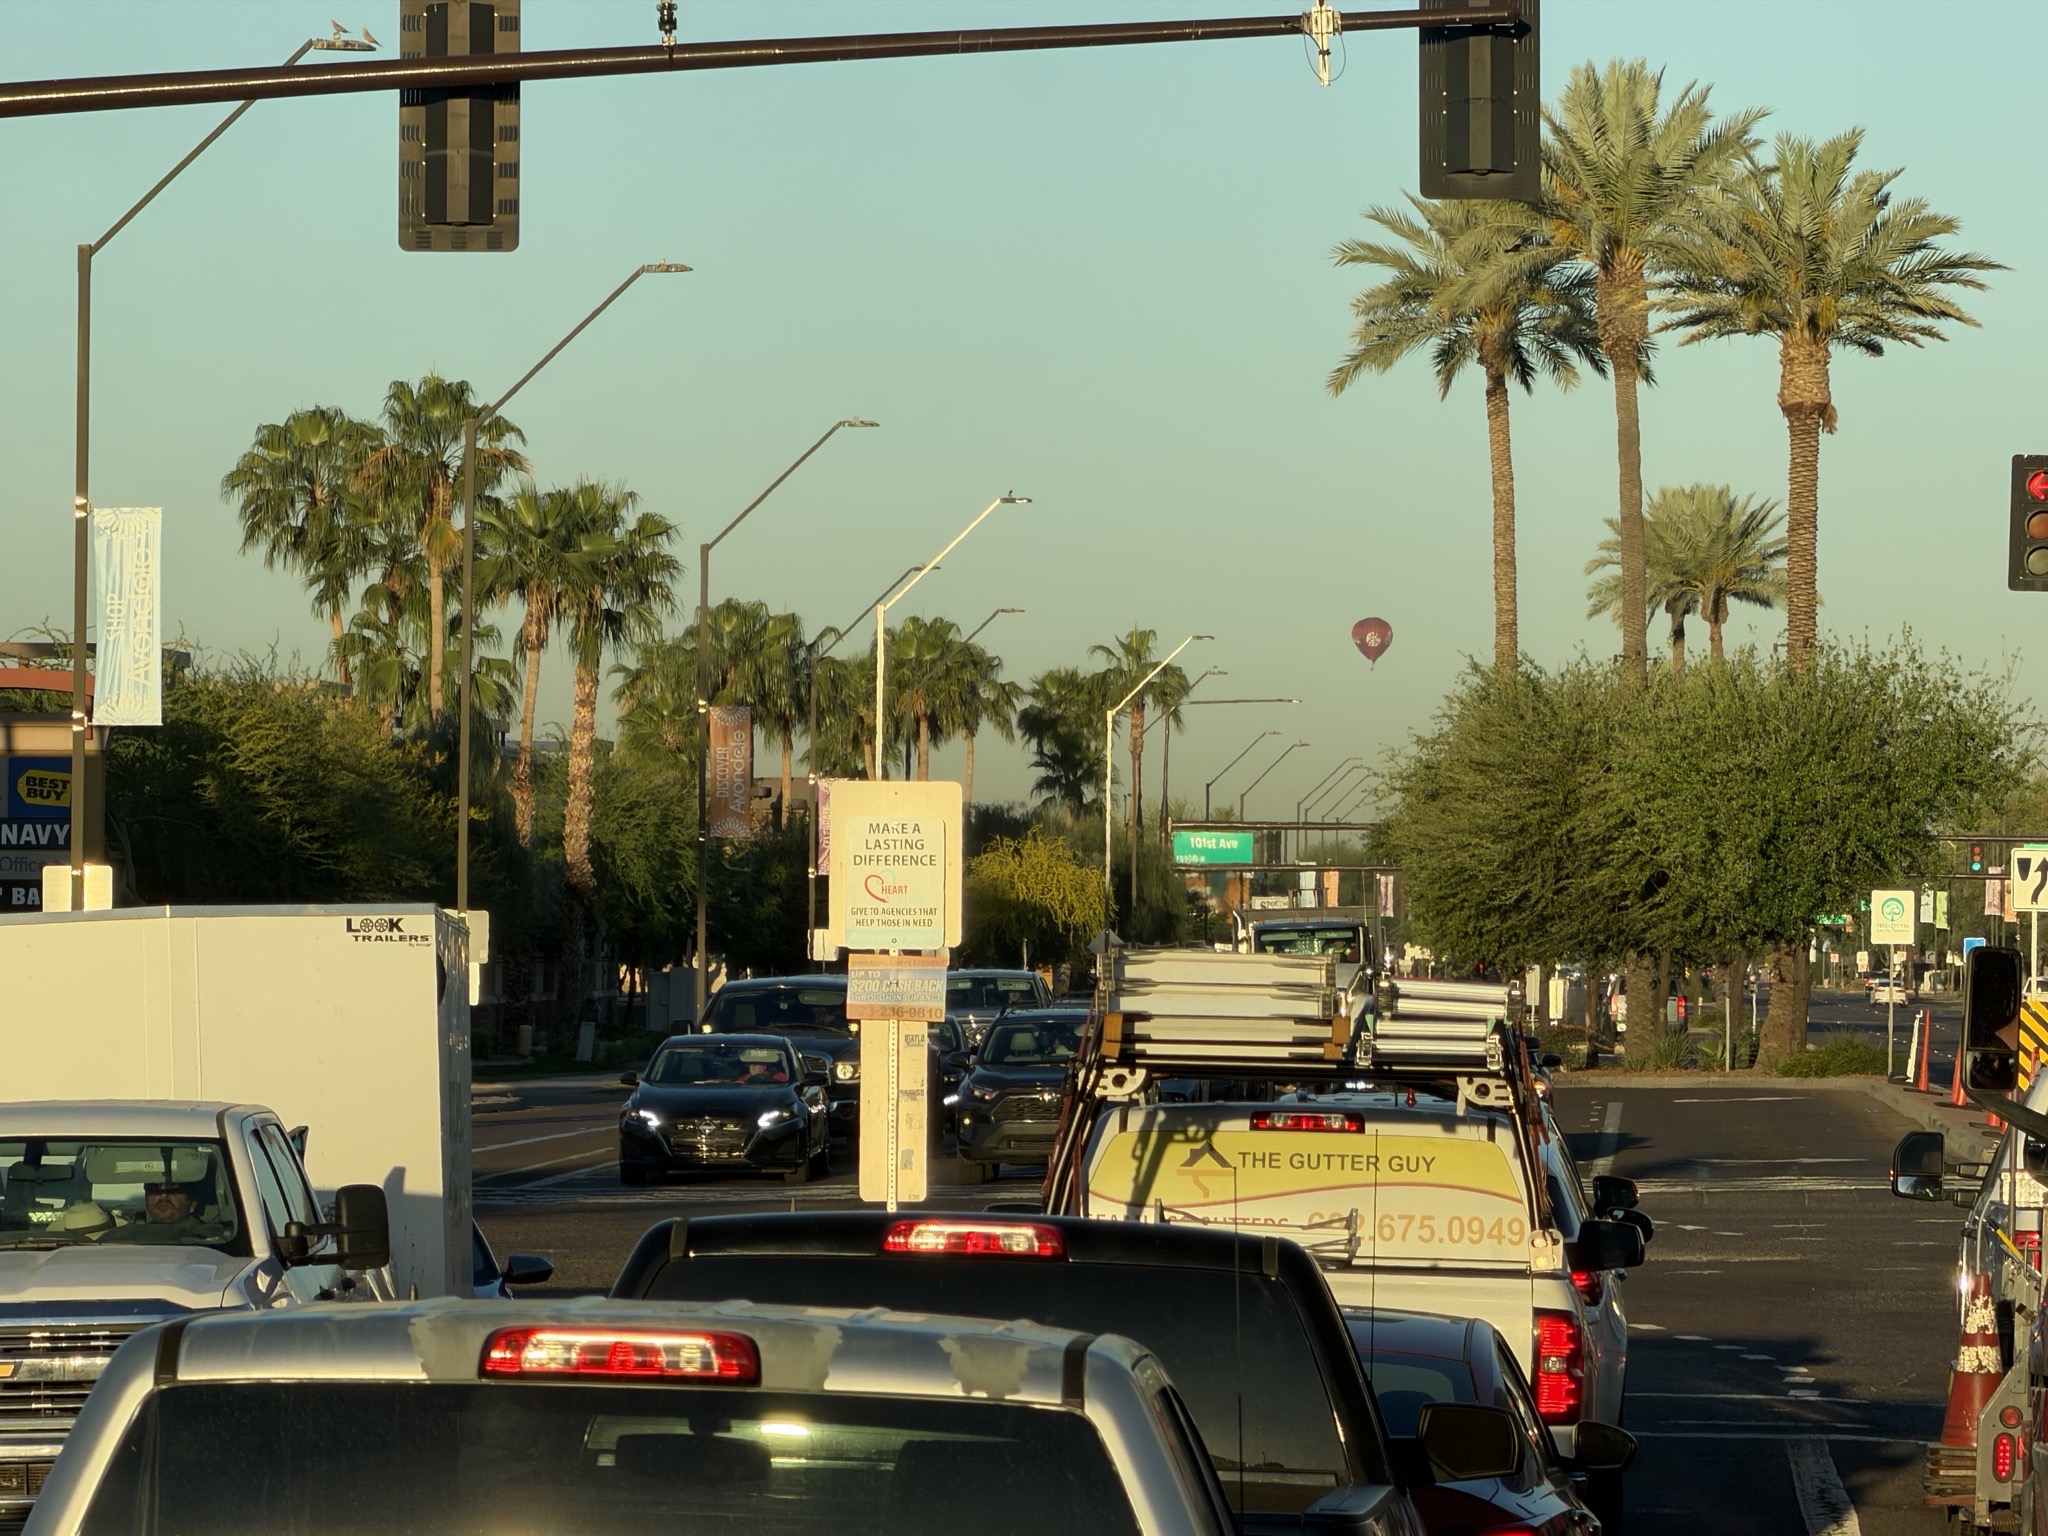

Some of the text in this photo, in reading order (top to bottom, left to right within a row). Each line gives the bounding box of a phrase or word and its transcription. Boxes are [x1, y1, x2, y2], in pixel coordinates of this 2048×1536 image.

[106, 593, 126, 642] SHOP
[716, 746, 729, 799] DISCOVER
[729, 730, 746, 815] Avondale
[25, 775, 70, 791] BEST
[26, 787, 65, 801] BUY
[1, 823, 70, 845] NAVY
[868, 823, 921, 834] MAKE A
[865, 839, 925, 850] LASTING
[1190, 837, 1239, 849] 101st Ave
[853, 854, 937, 866] DIFFERENCE
[12, 887, 41, 905] BA
[881, 885, 908, 895] HEART
[850, 907, 938, 916] GIVE TO AGENCIES THAT
[346, 918, 405, 933] LOOK
[855, 918, 933, 927] HELP THOSE IN NEED
[352, 934, 430, 943] TRAILERS
[851, 970, 881, 978] UP TO
[850, 979, 945, 993] $200 CASH BACK
[851, 993, 942, 1003] THROUGH INSURANCE
[855, 1006, 944, 1019] -236-9810
[1238, 1151, 1437, 1173] THE GUTTER GUY
